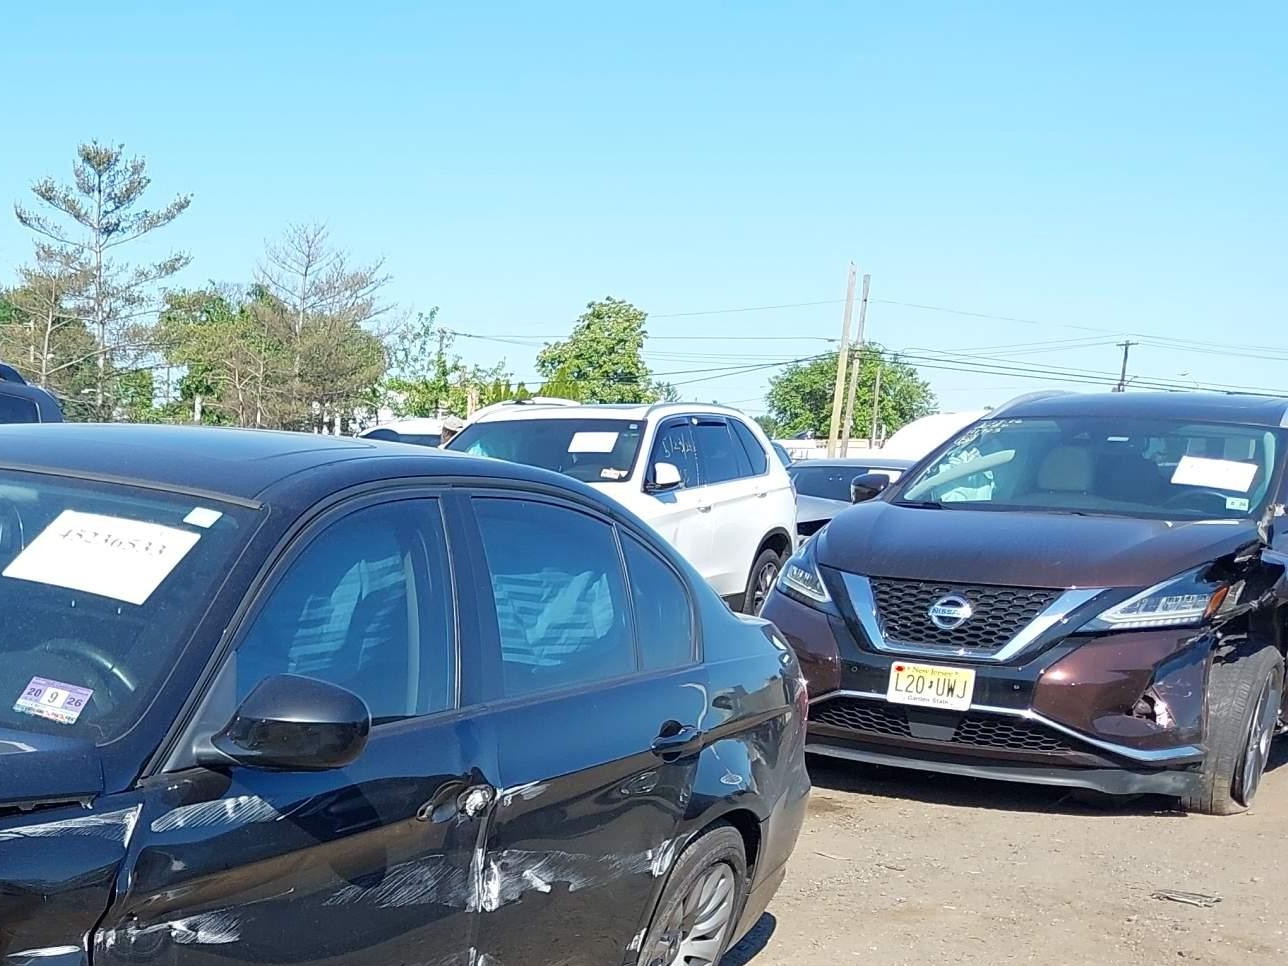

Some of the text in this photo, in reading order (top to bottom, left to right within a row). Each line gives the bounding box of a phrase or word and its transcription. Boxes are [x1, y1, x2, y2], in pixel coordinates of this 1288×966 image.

[27, 687, 83, 707] 20 9 26
